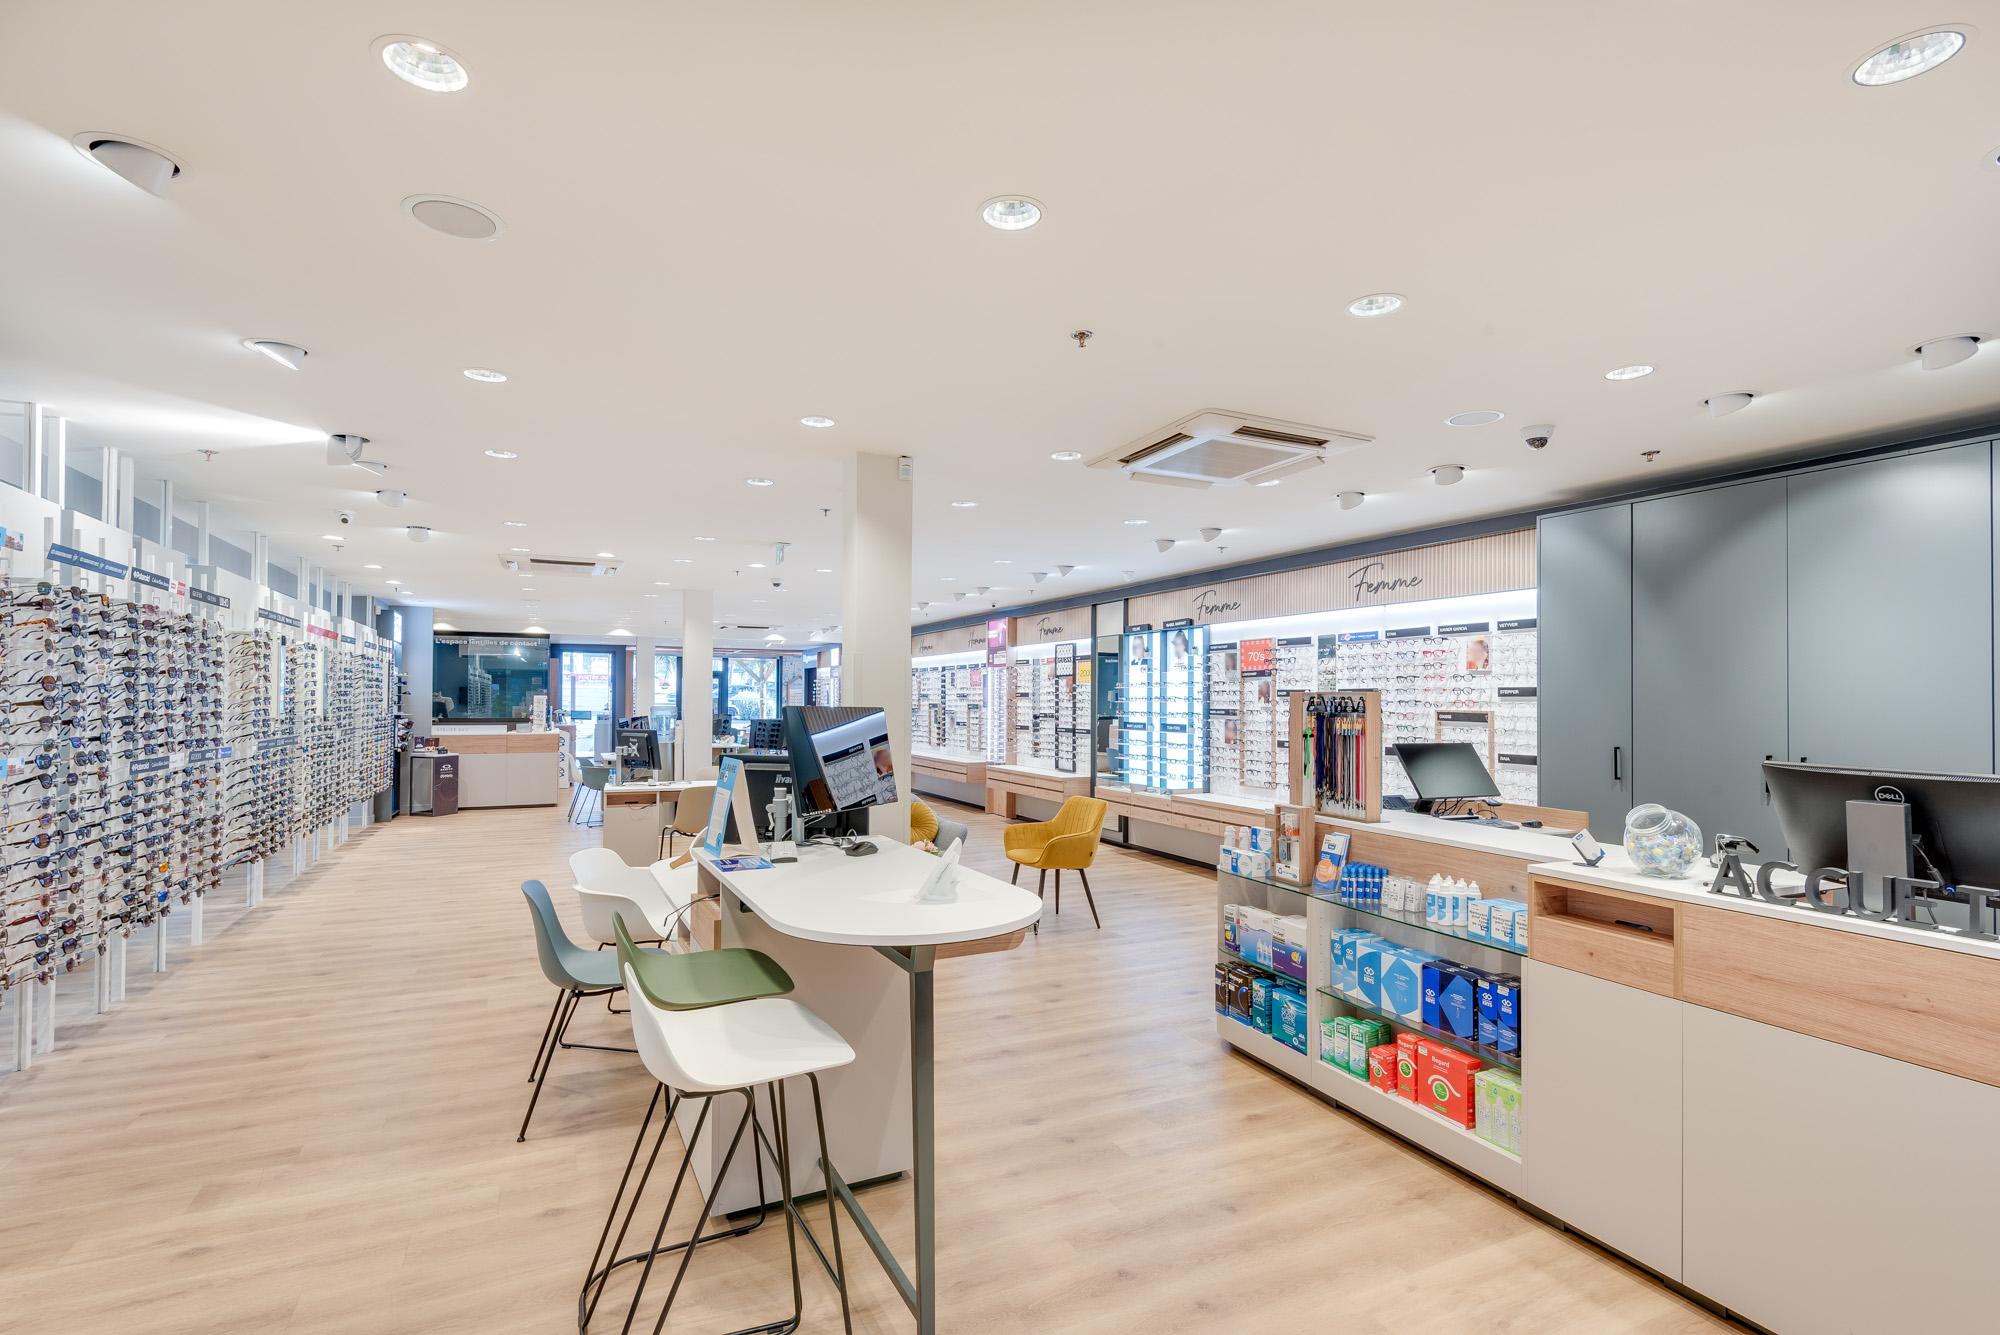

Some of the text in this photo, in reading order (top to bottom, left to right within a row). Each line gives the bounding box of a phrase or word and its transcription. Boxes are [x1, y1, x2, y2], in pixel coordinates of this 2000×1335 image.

[1348, 562, 1423, 602] Femme
[1193, 589, 1241, 621] Femme
[1036, 616, 1064, 640] Femme
[435, 638, 468, 646] L'espace
[1057, 656, 1072, 664] GUESS
[1247, 651, 1265, 662] 70's
[1878, 792, 1902, 800] DELL
[1431, 1055, 1450, 1068] Regard
